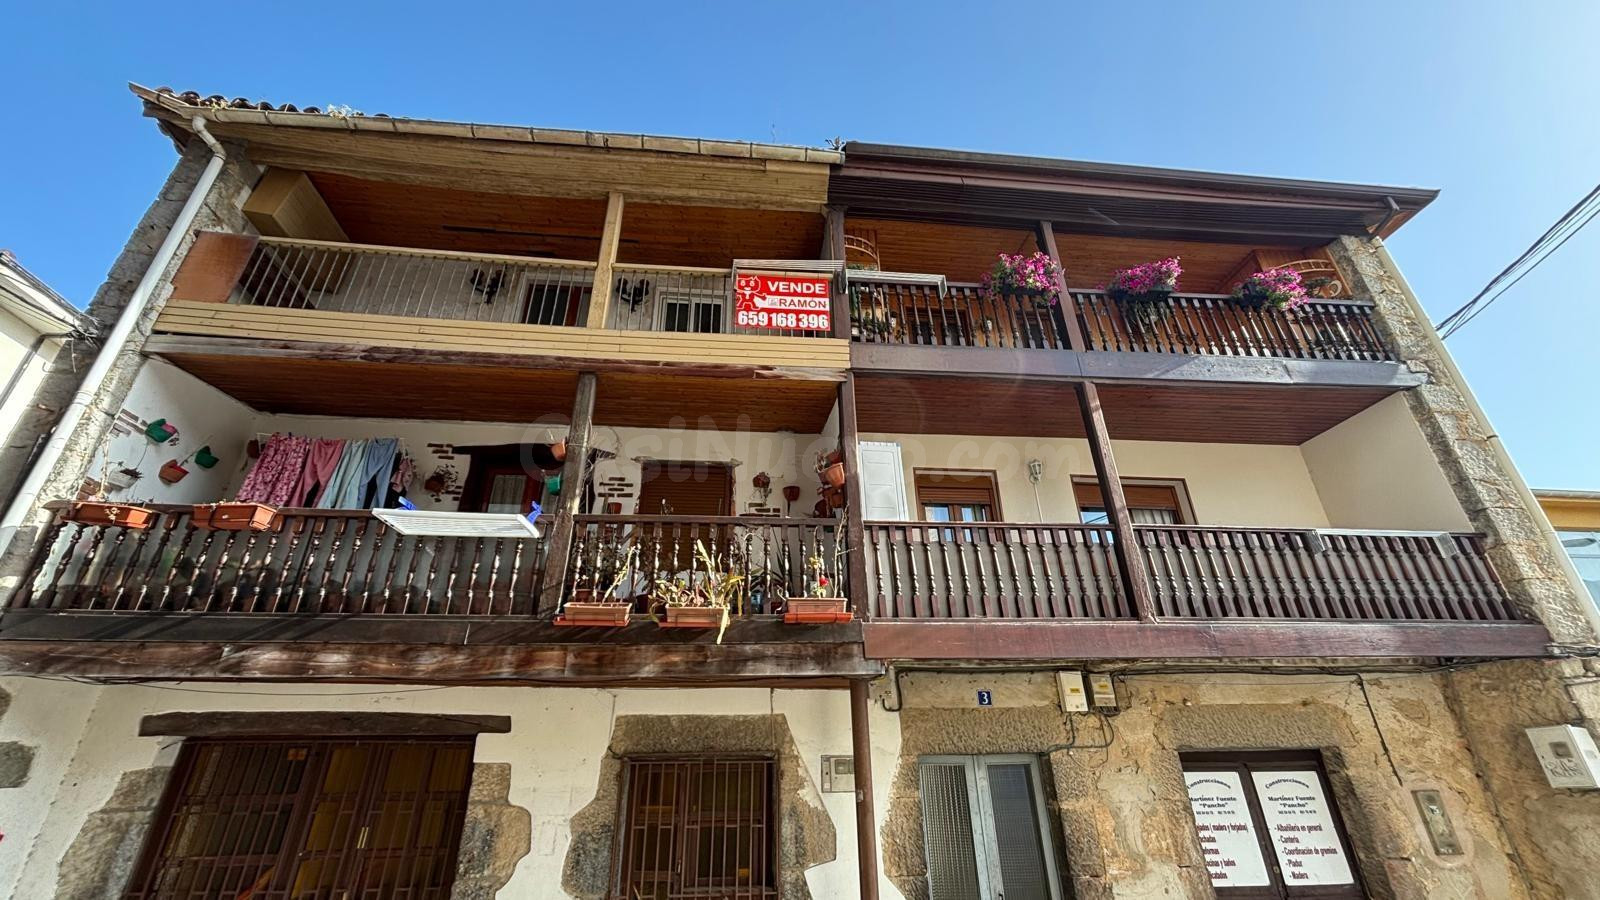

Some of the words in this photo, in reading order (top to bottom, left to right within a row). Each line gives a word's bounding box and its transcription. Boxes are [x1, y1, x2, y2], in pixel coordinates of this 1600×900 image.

[768, 281, 826, 294] VENDE
[779, 298, 827, 308] RAMÓN
[738, 310, 768, 326] 659
[769, 312, 797, 328] 168
[798, 314, 829, 329] 396
[982, 692, 989, 704] 3
[1265, 778, 1310, 789] Construcciones
[1307, 824, 1322, 833] general
[1314, 847, 1320, 855] de
[1320, 846, 1338, 857] gremios
